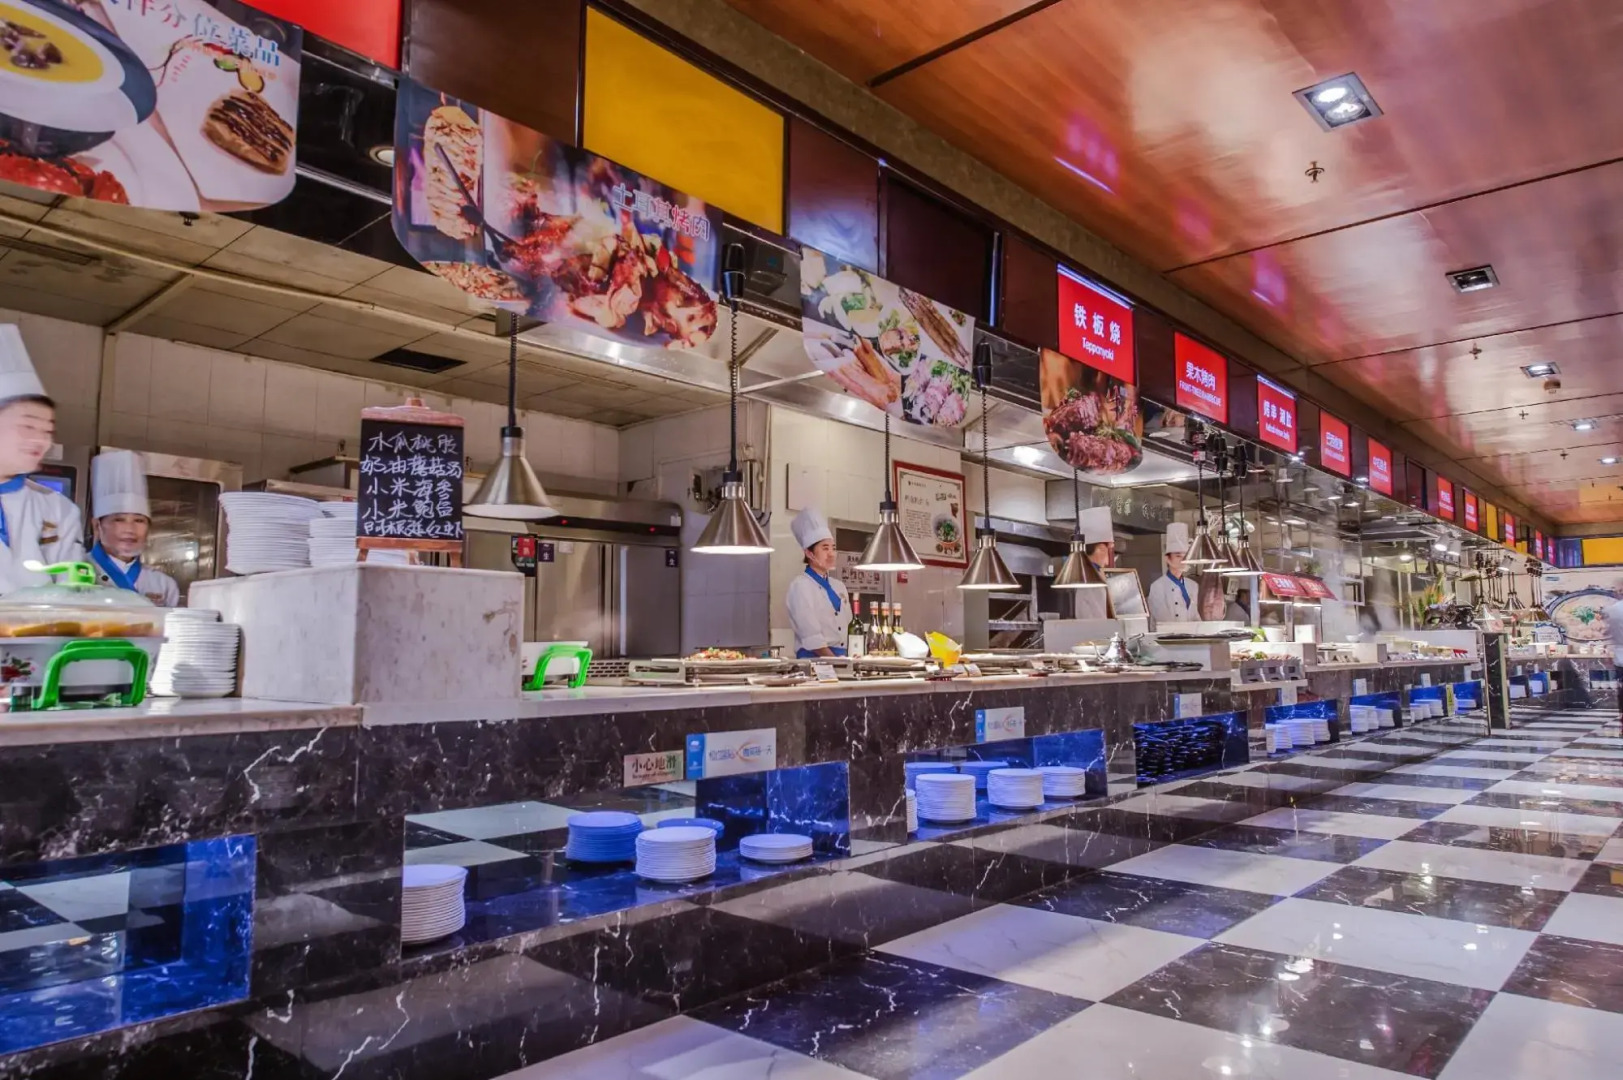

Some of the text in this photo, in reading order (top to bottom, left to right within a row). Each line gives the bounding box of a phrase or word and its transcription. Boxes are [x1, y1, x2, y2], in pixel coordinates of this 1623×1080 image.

[612, 182, 711, 242] 土耳其烤肉
[1074, 302, 1121, 346] 铁板烧
[360, 453, 462, 479] 奶油蘑菇汤
[366, 476, 454, 501] 小米海参
[364, 518, 464, 539] 阿根廷红虾
[632, 754, 677, 773] 小心地滑
